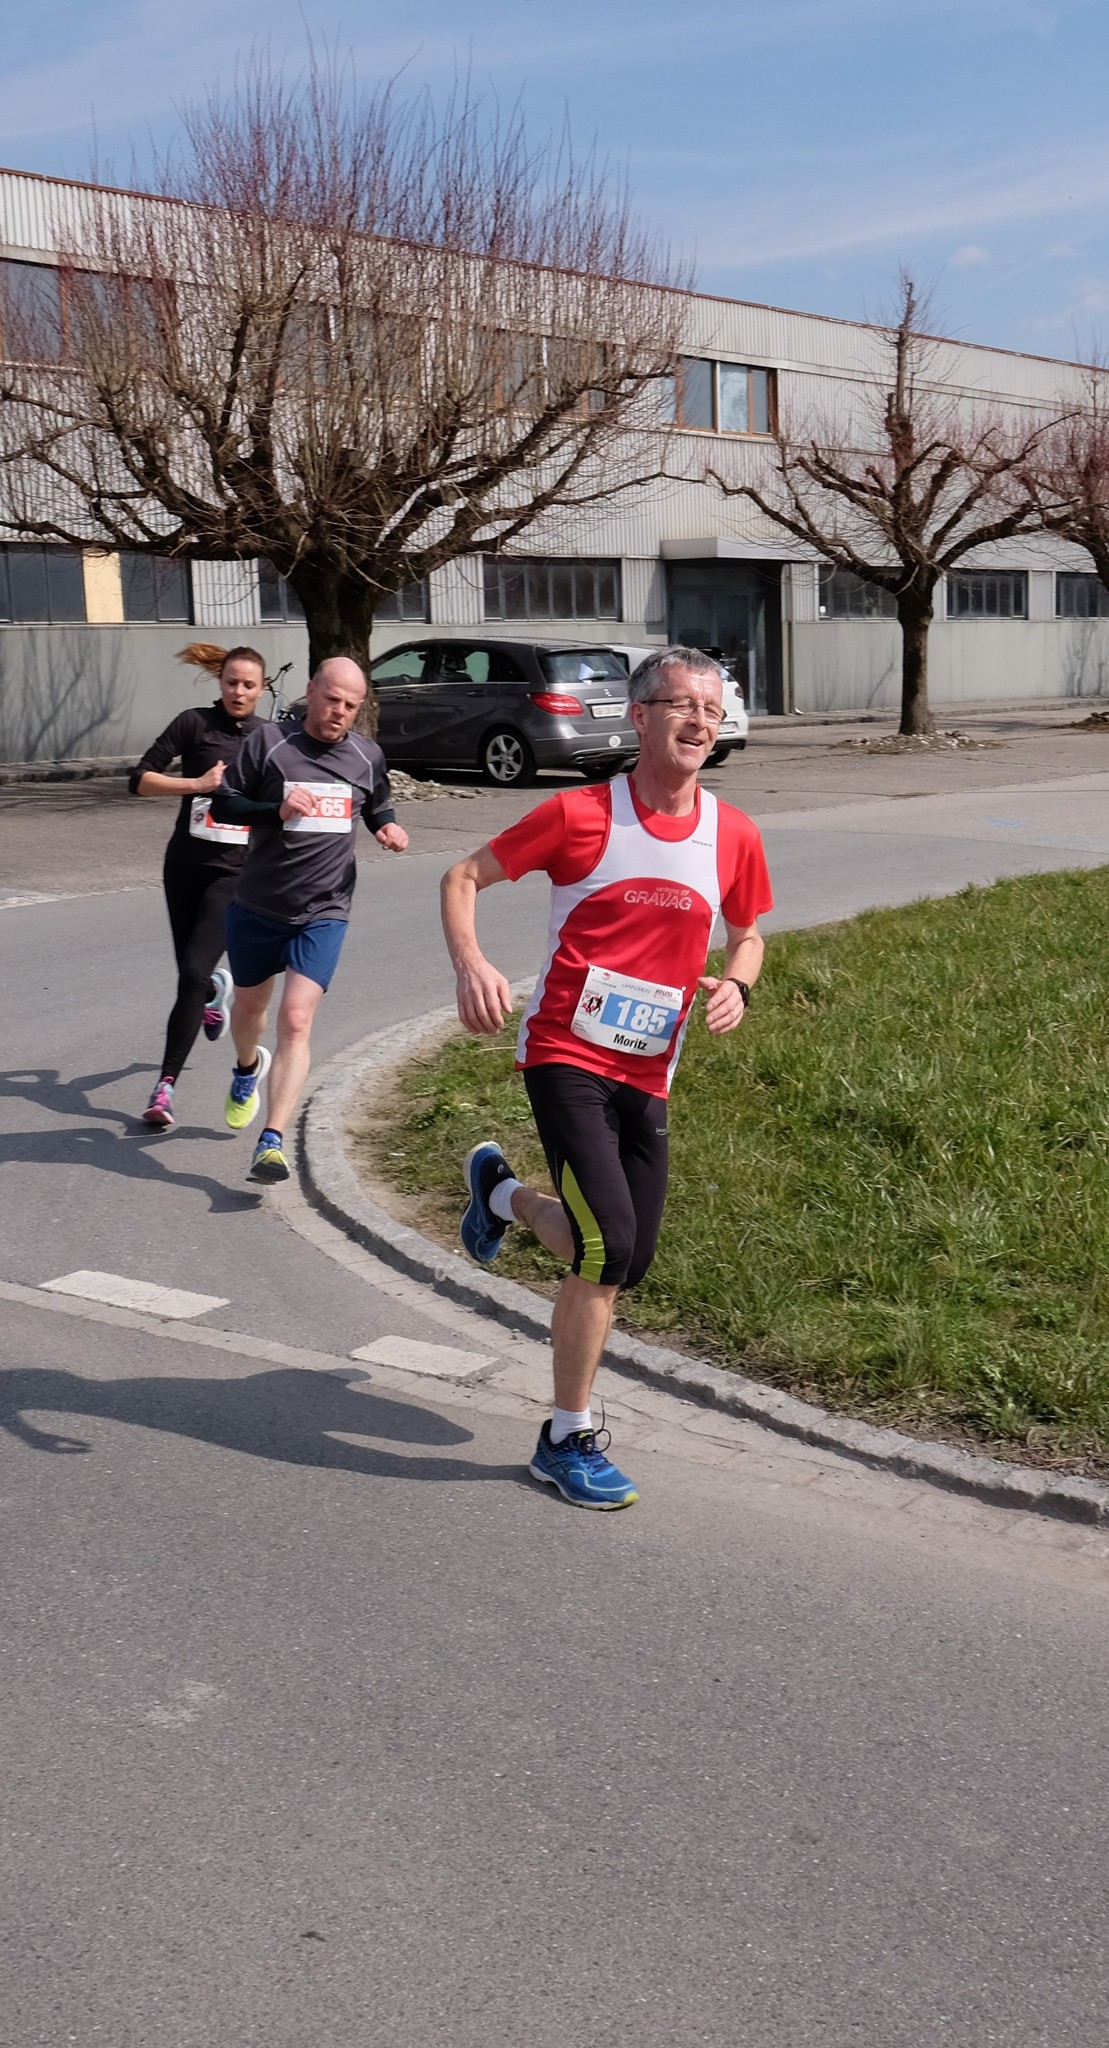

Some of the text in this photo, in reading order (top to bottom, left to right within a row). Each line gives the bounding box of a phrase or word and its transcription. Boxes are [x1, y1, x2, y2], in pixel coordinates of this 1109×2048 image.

[310, 798, 346, 818] 65
[624, 890, 692, 911] GRAVAG
[617, 999, 669, 1035] 185
[613, 1033, 648, 1051] Moritz
